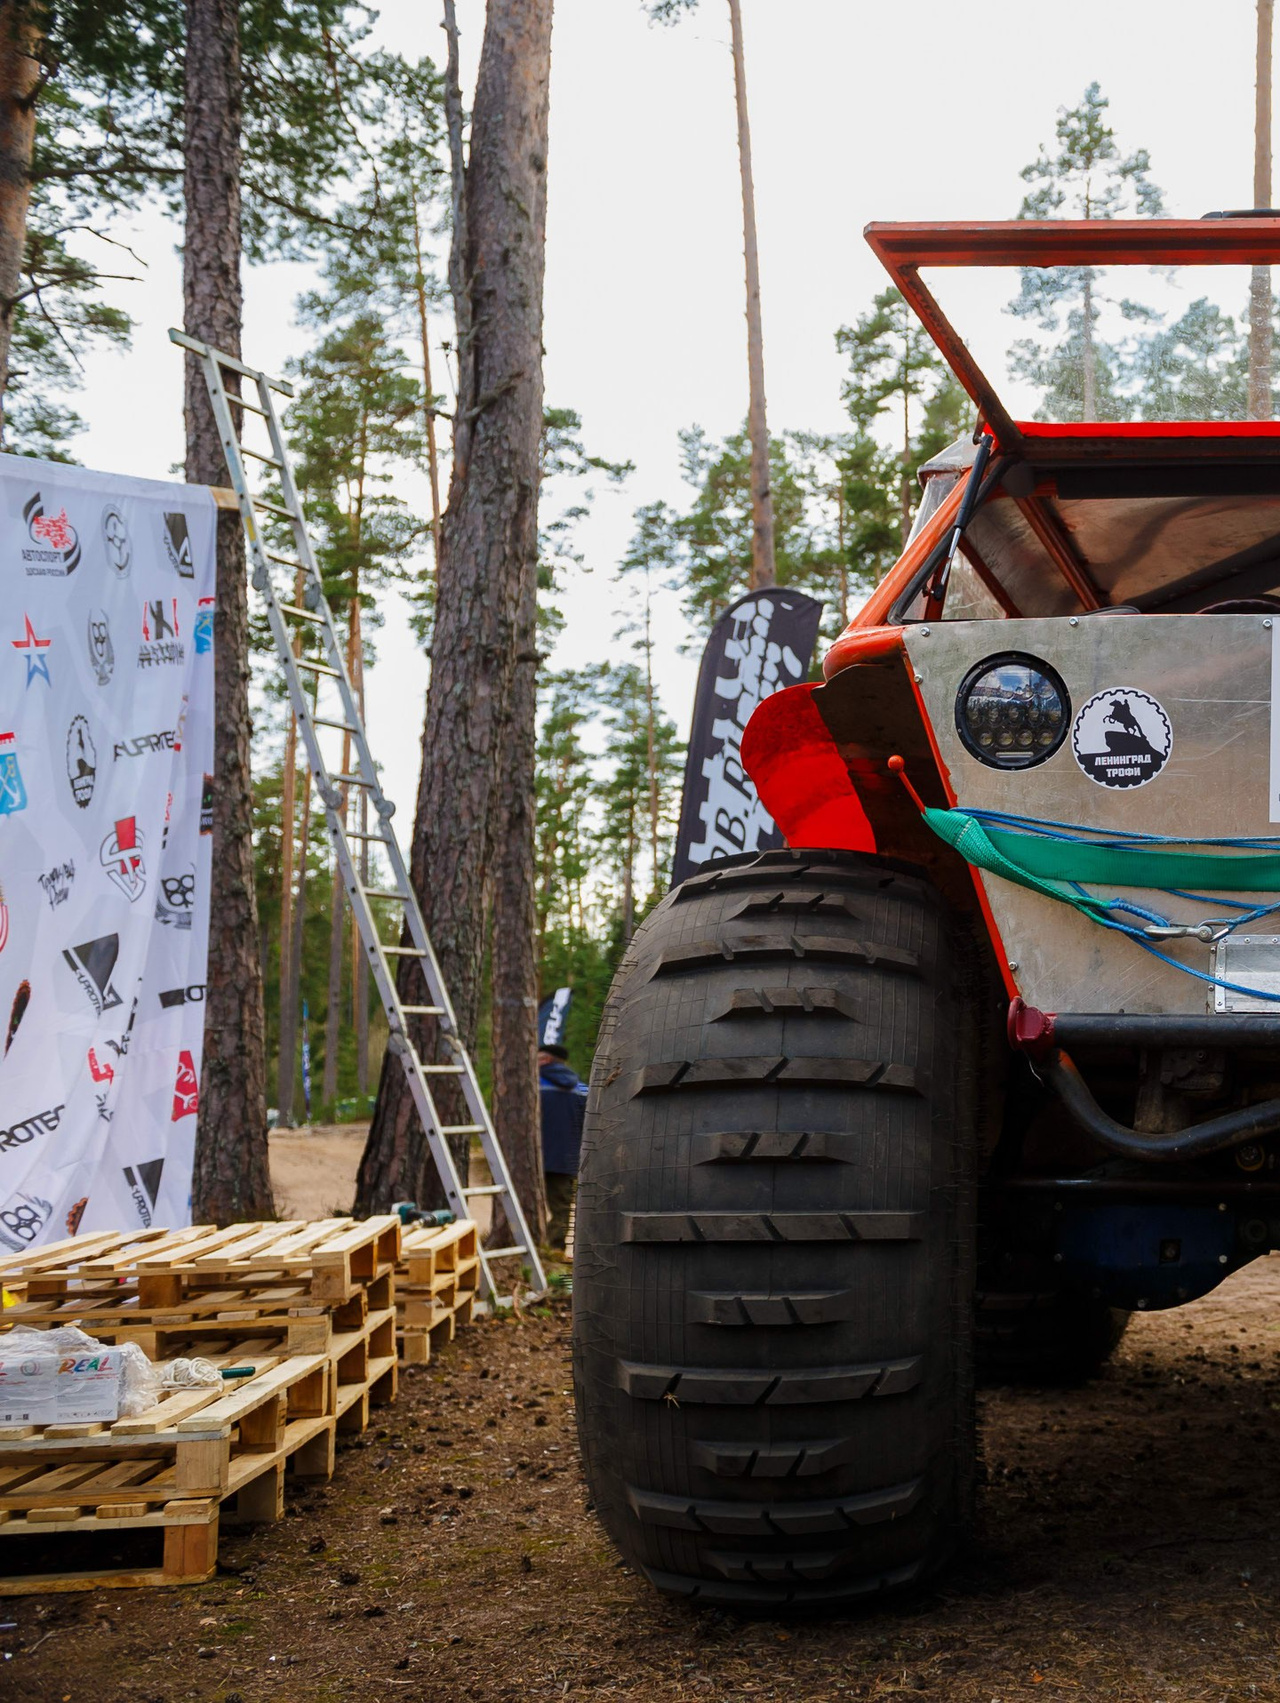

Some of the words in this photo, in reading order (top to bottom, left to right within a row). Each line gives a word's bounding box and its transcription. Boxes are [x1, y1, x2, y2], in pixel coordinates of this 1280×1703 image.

[1094, 754, 1152, 766] ЛЕНИНГРАД
[1106, 767, 1141, 778] ТРОФИ
[58, 1356, 113, 1374] REAL
